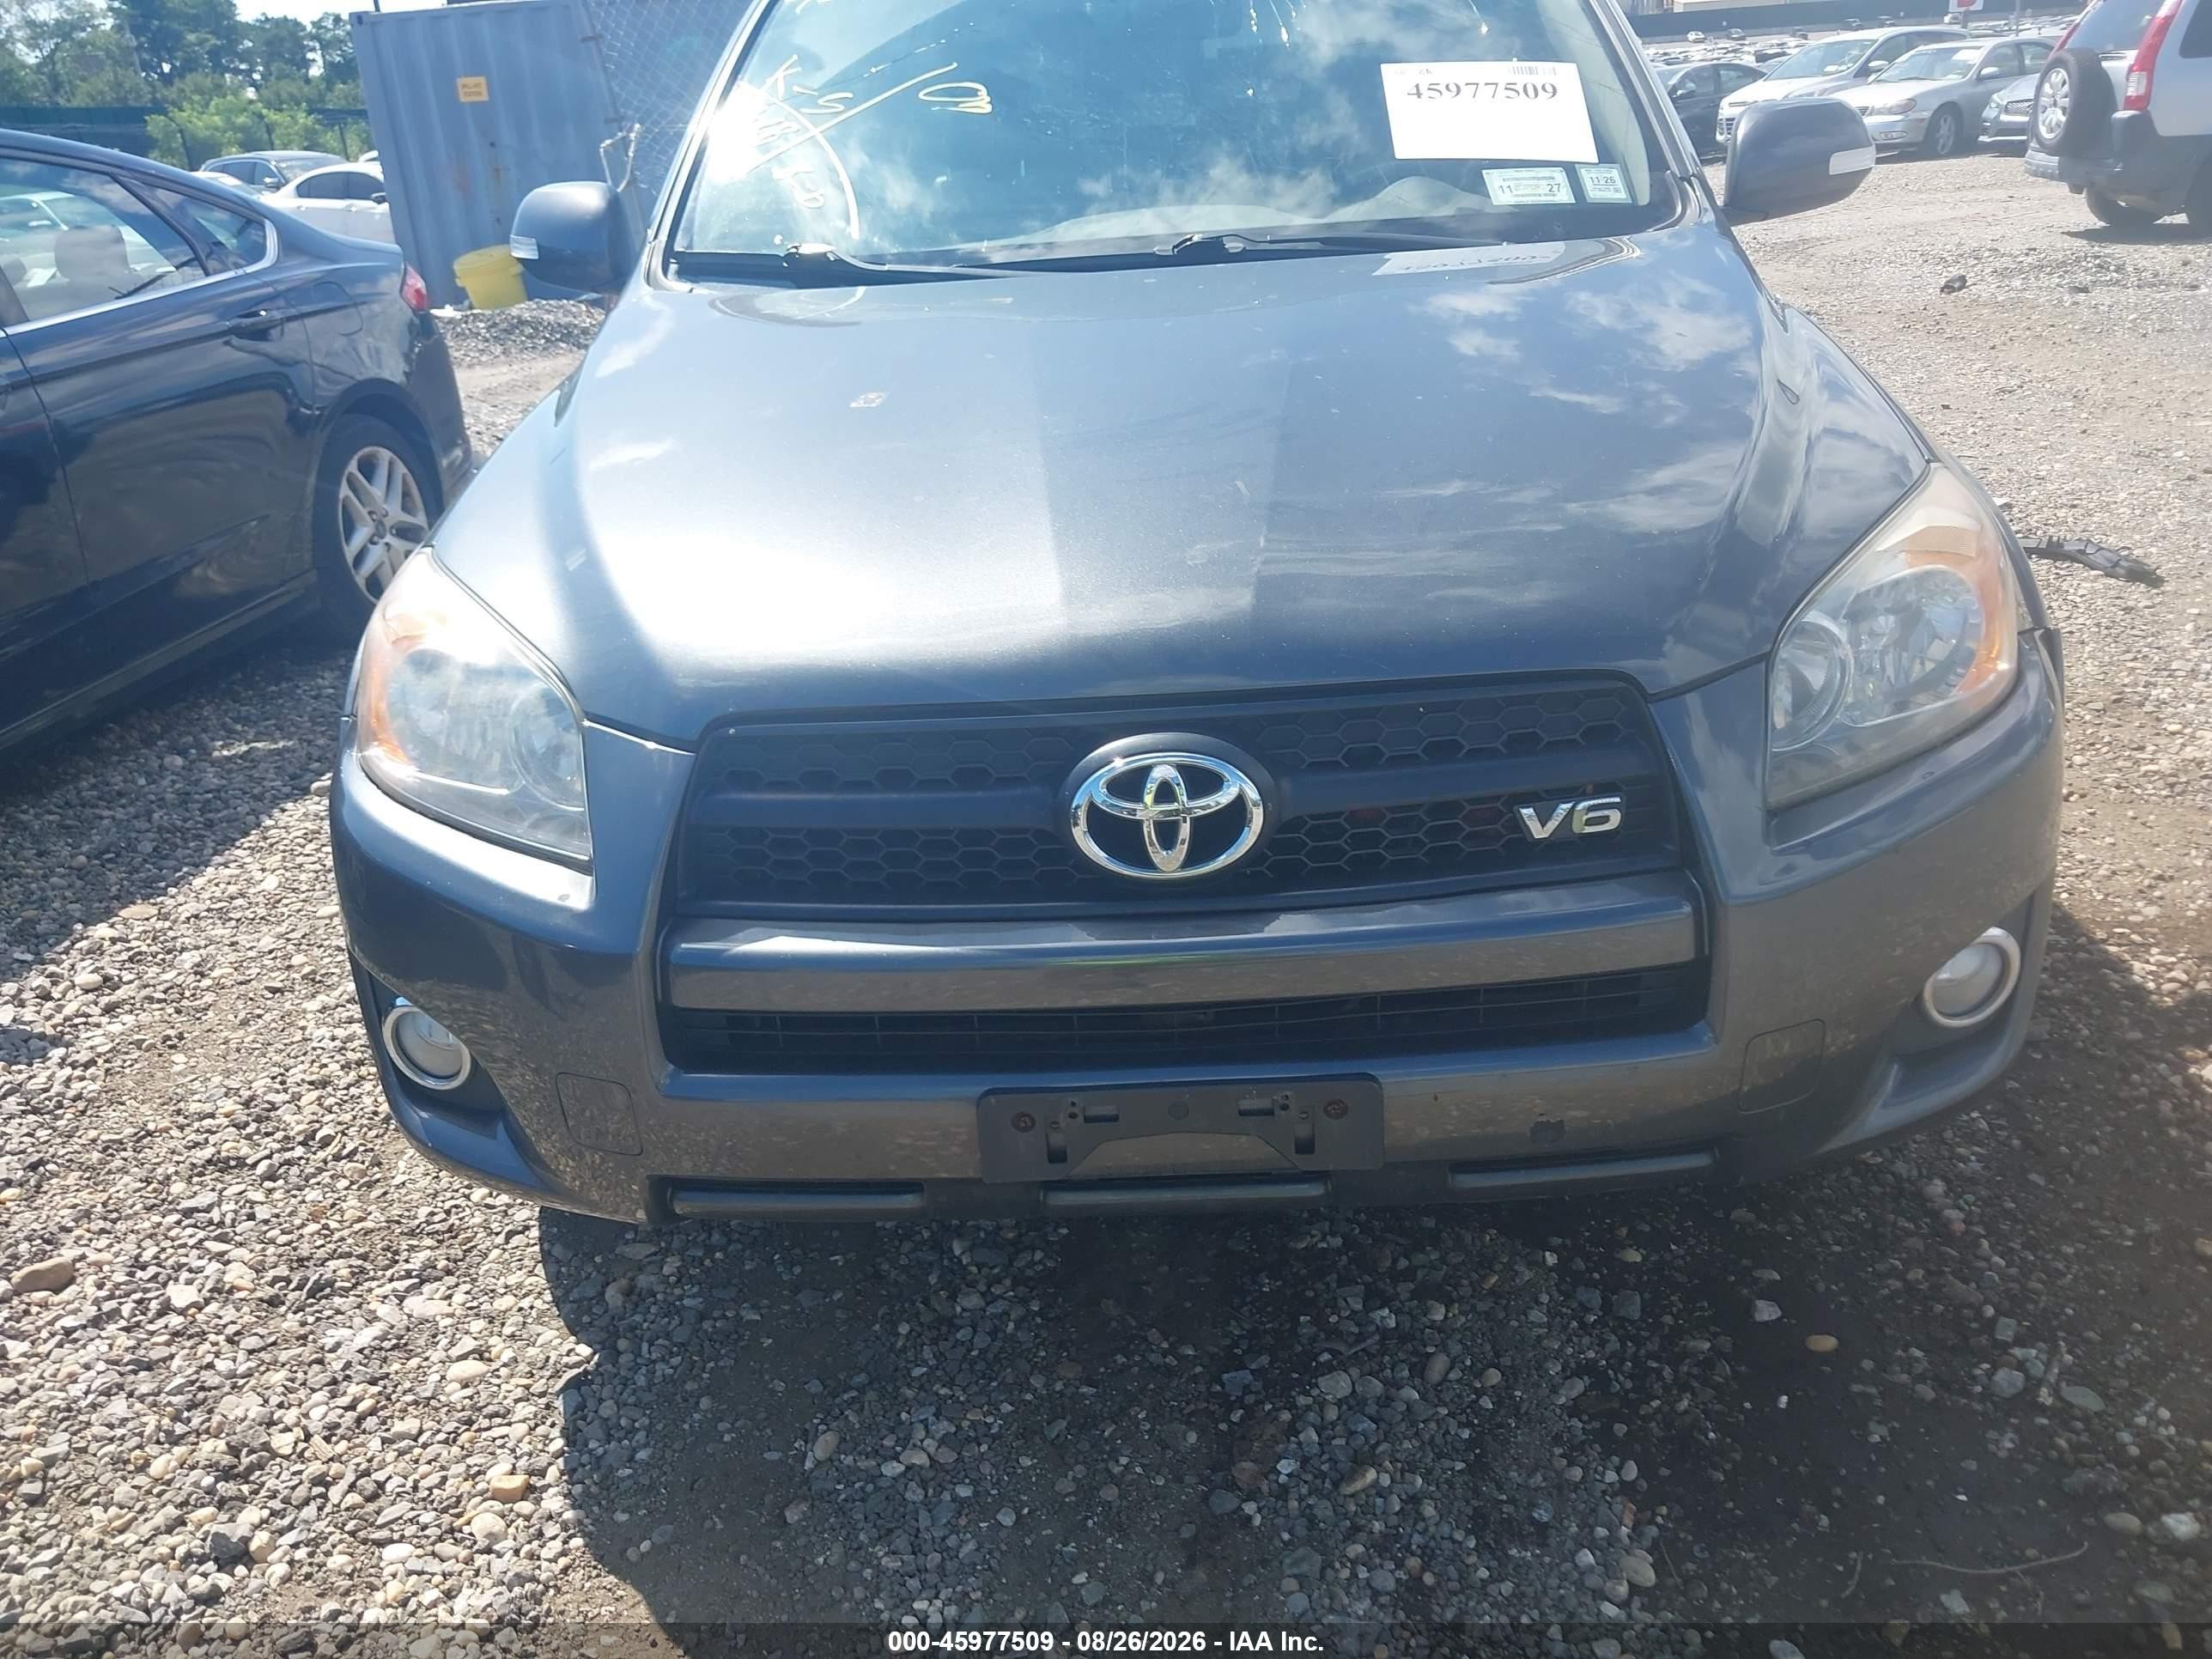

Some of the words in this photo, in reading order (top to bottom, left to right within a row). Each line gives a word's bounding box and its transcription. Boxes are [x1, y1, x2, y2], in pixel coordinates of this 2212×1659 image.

[1406, 82, 1559, 100] 45977509
[1546, 183, 1562, 193] 27
[1518, 796, 1623, 840] V6
